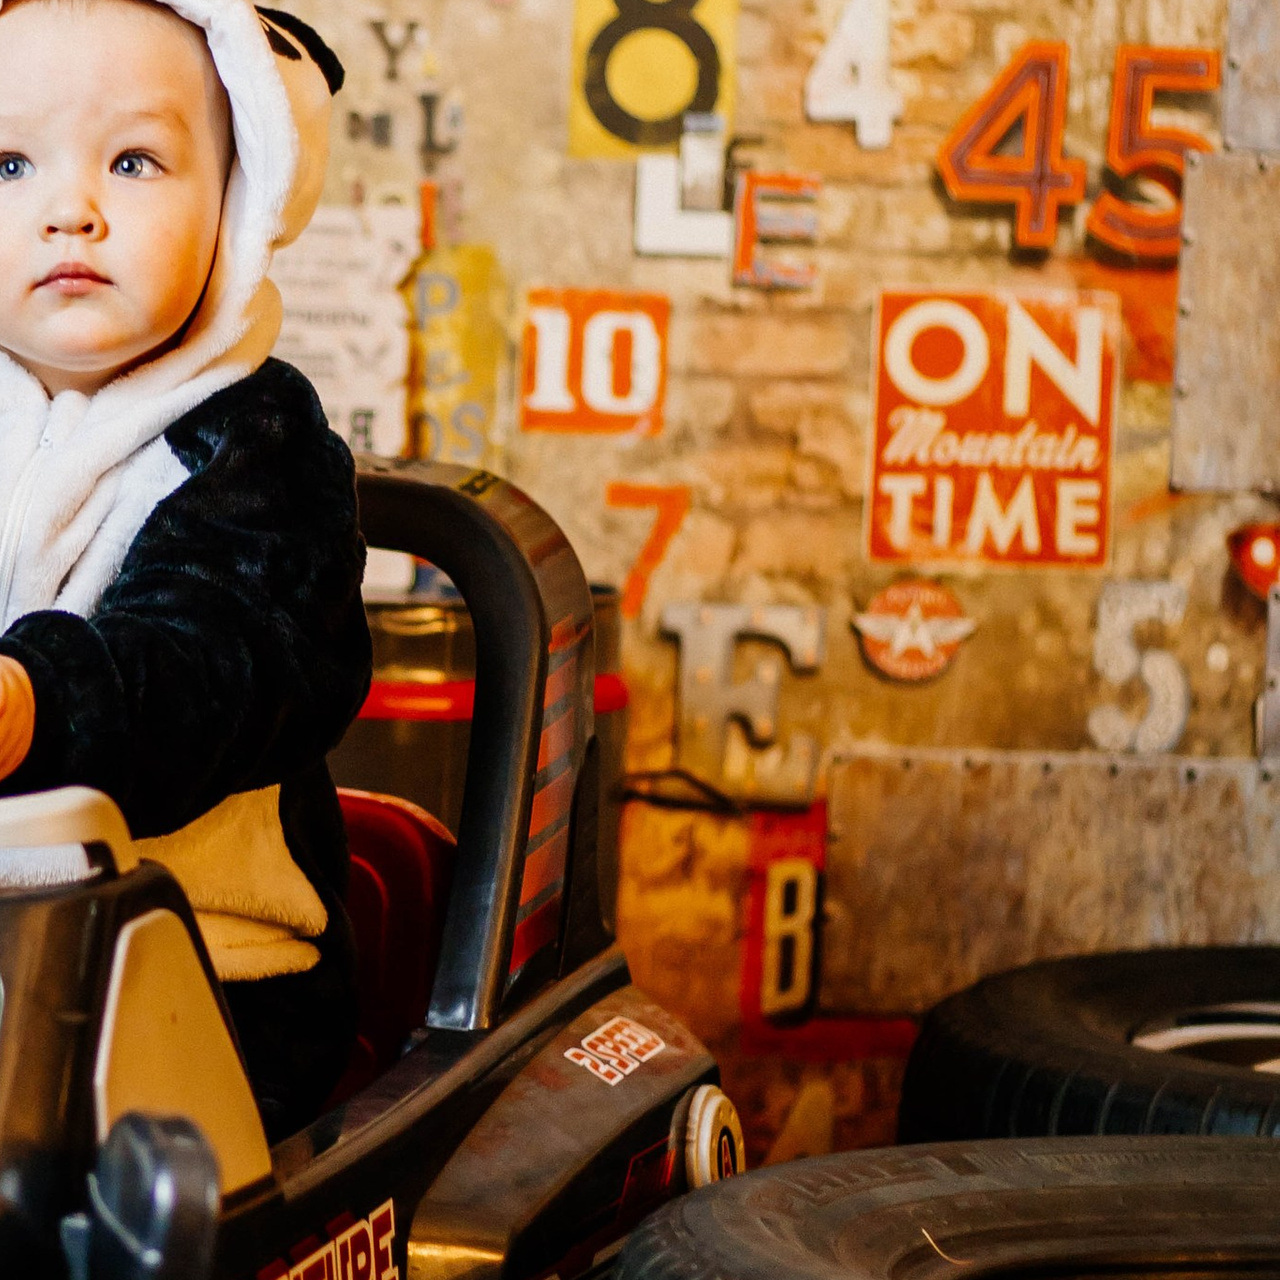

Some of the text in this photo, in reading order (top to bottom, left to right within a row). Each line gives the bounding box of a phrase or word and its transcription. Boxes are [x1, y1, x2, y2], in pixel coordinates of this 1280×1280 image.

[525, 307, 660, 415] 10
[884, 300, 1108, 428] ON
[882, 408, 1104, 470] Mountain
[607, 483, 691, 617] 7
[878, 474, 1104, 556] TIME
[1088, 580, 1190, 754] 5
